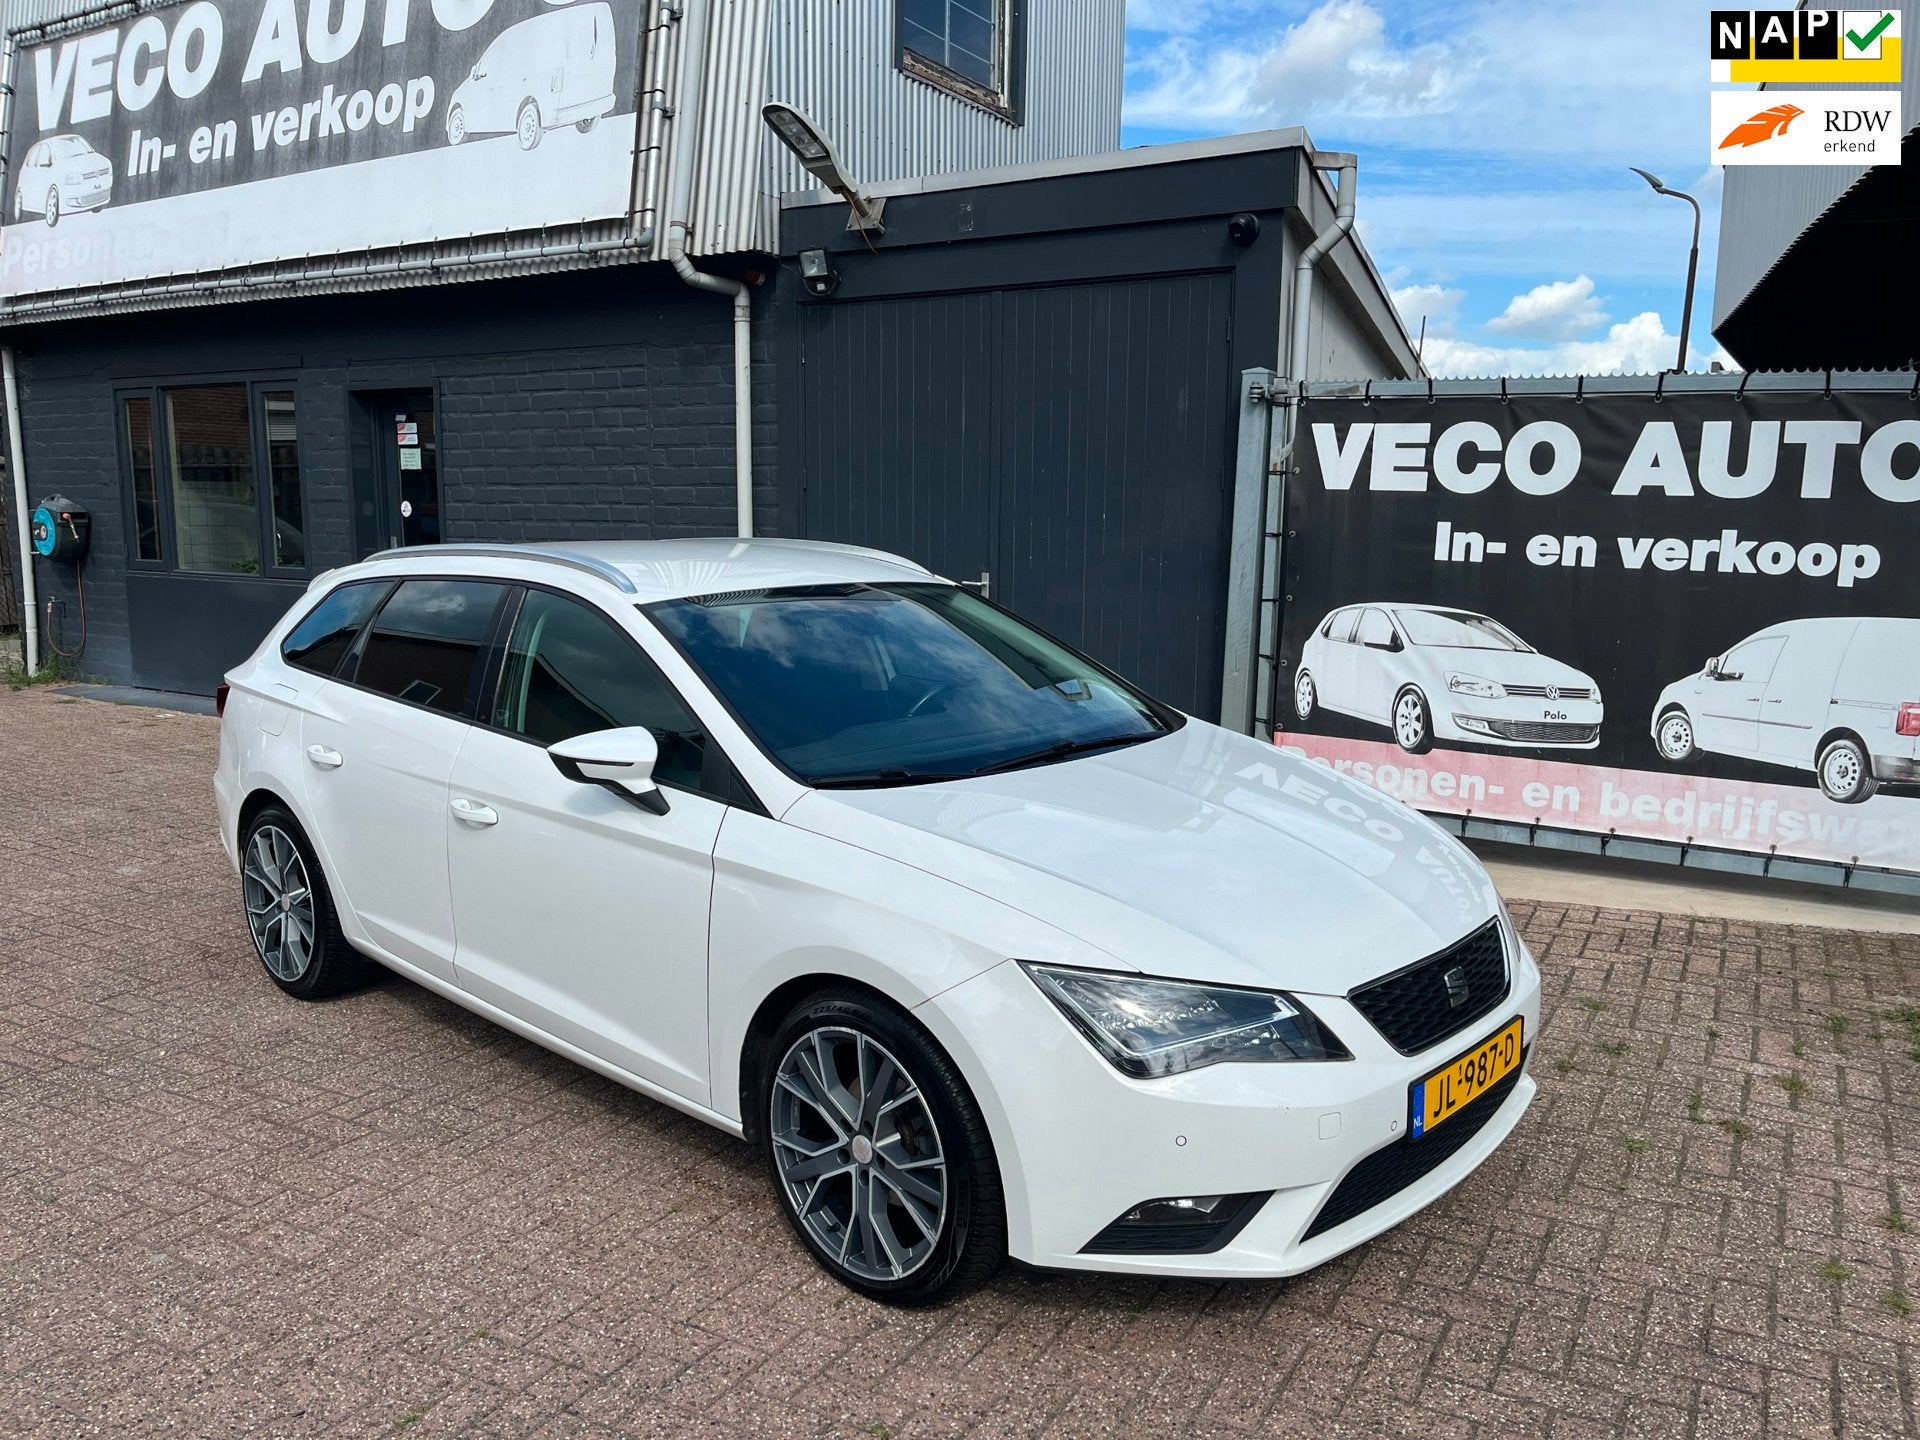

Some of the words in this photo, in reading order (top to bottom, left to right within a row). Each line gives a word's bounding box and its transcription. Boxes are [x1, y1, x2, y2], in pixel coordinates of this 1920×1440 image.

[34, 0, 224, 133] VECO
[126, 130, 177, 177] In-
[189, 119, 235, 164] en
[253, 75, 434, 148] verkoop
[1312, 420, 1582, 495] VECO
[1434, 521, 1506, 562] In-
[1526, 534, 1597, 568] en
[1618, 529, 1881, 587] verkoop
[1543, 710, 1568, 720] Polo
[1522, 779, 1580, 814] en
[1413, 1115, 1423, 1128] NL
